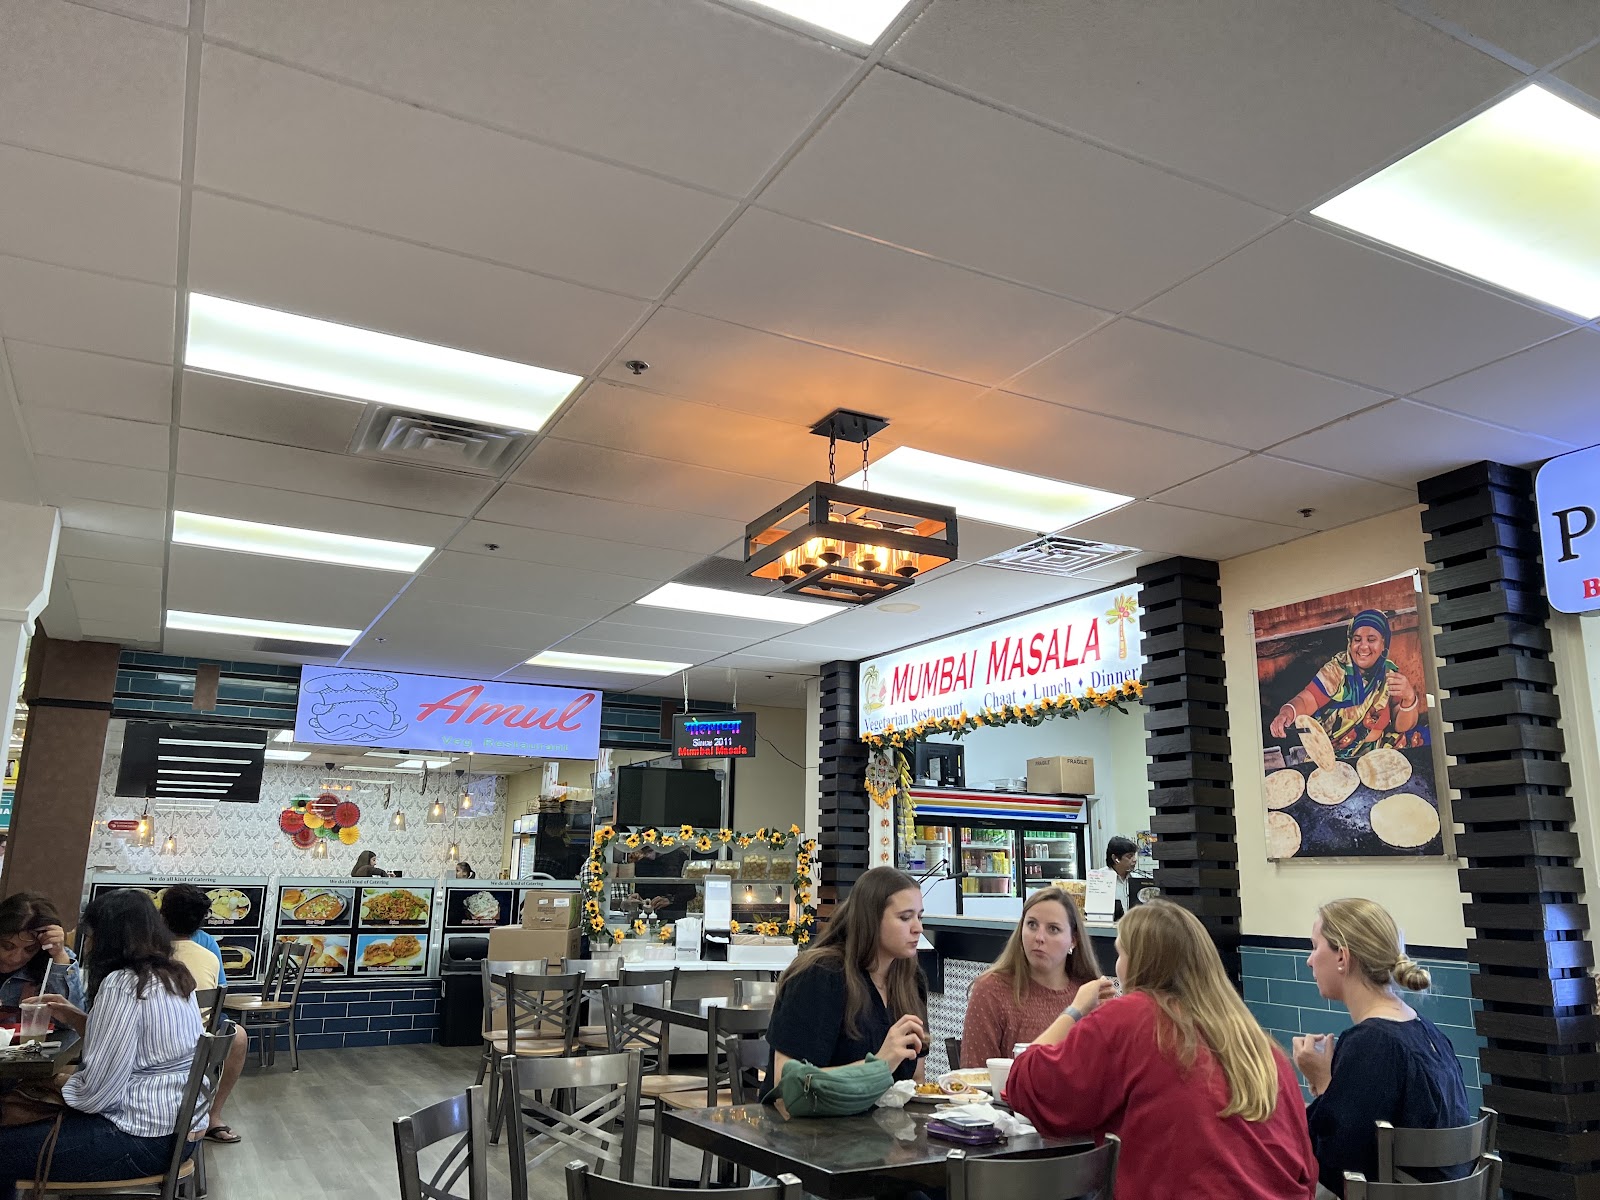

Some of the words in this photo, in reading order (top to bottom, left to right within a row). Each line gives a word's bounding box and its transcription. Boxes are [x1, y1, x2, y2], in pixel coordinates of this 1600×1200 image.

[890, 650, 978, 705] MUMBAI
[986, 617, 1101, 685] MASALA
[984, 690, 1017, 708] Chaat
[1033, 677, 1072, 700] Lunch
[1091, 667, 1139, 689] Dinner
[416, 684, 596, 732] Amul
[864, 712, 909, 732] Vegetarian
[911, 700, 963, 723] Restaurant
[441, 735, 473, 748] Veg
[483, 738, 569, 752] Restaurant
[678, 746, 714, 756] Mumbai
[715, 745, 748, 755] Masala
[692, 738, 713, 747] Since
[713, 737, 732, 746] 2011
